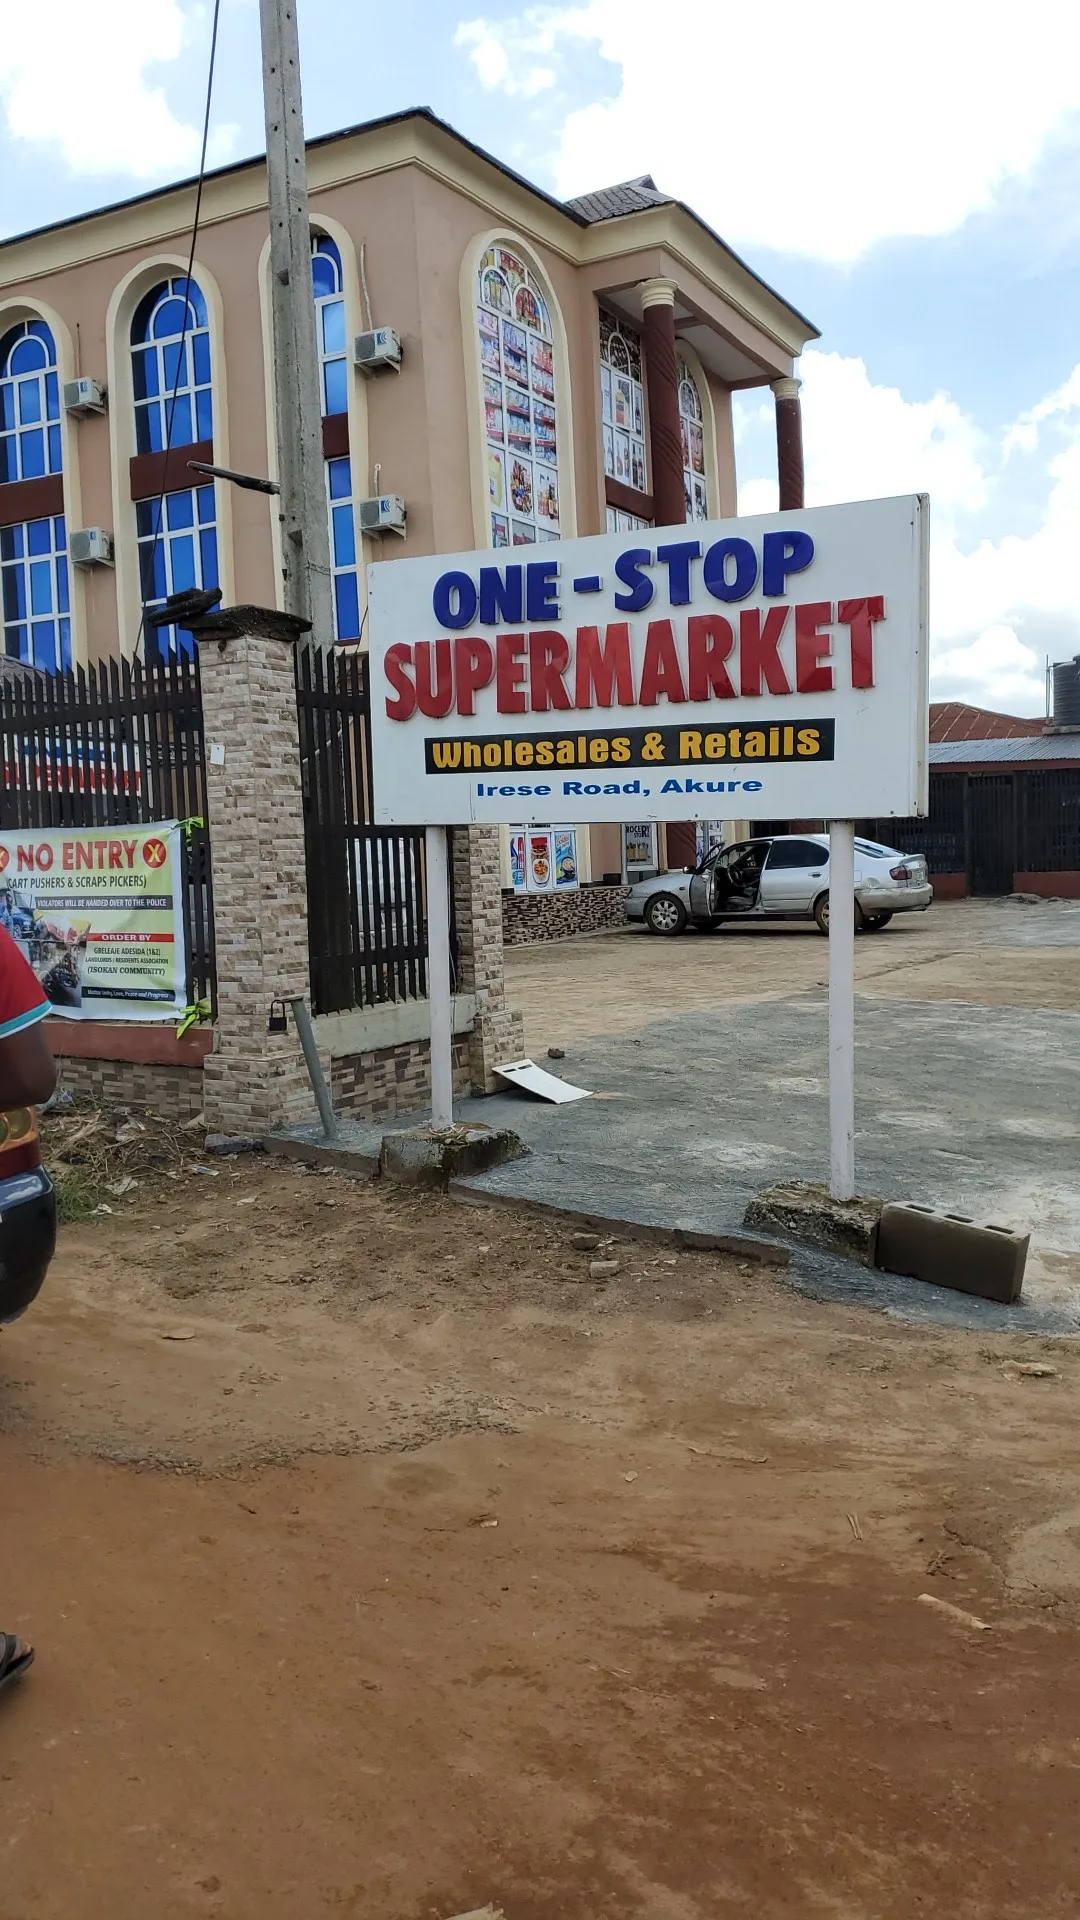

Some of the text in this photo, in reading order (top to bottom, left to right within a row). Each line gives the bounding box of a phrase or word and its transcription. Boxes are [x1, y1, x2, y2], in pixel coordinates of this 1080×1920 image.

[384, 595, 886, 722] SUPERMARKET
[432, 727, 821, 770] Wholesales & Retails
[477, 778, 763, 798] Irese Road, Akure
[17, 843, 54, 872] NO
[62, 839, 138, 870] ENTRY
[30, 877, 65, 888] PUSHERS
[68, 876, 74, 888] &
[76, 875, 107, 888] SCRAPS
[109, 874, 147, 889] PICKERS)
[37, 899, 64, 907] VIOLATORS
[64, 899, 77, 907] WILL
[77, 899, 85, 907] BE
[109, 899, 124, 907] OVER
[125, 899, 132, 907] TO
[133, 899, 145, 907] THE
[146, 898, 167, 907] POLICE
[119, 967, 165, 976] COMMUNITY)
